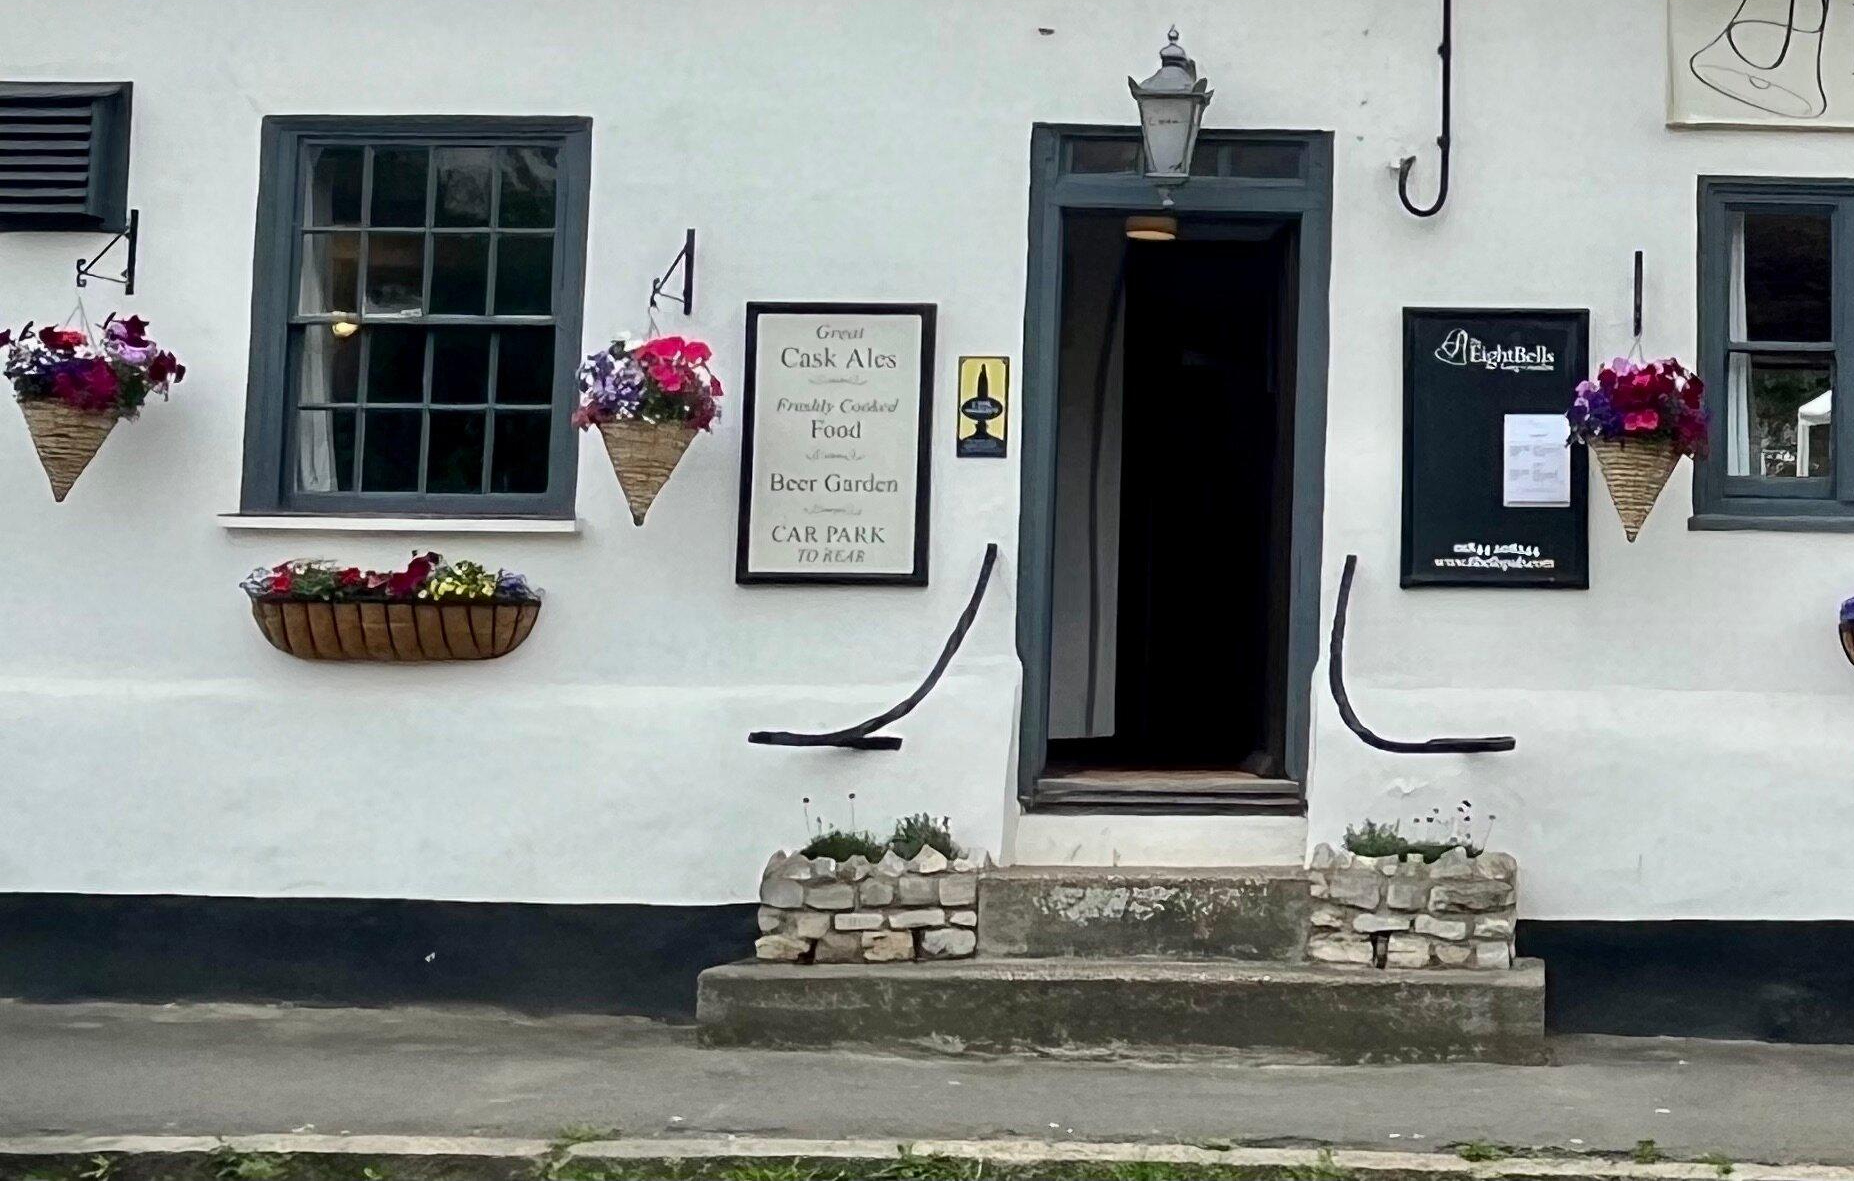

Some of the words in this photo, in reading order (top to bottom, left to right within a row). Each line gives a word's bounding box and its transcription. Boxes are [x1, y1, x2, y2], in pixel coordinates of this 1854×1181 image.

[816, 324, 864, 340] Great
[781, 347, 836, 369] Cask
[846, 347, 897, 369] Ales
[1469, 344, 1555, 370] EightBells
[776, 397, 835, 416] Freshly
[840, 398, 899, 414] Cooked
[811, 419, 861, 439] Food
[770, 472, 818, 492] Beer
[824, 472, 899, 493] Garden
[771, 524, 819, 543] CAR
[826, 525, 886, 544] PARK
[798, 548, 819, 563] TO
[822, 548, 866, 563] REAR
